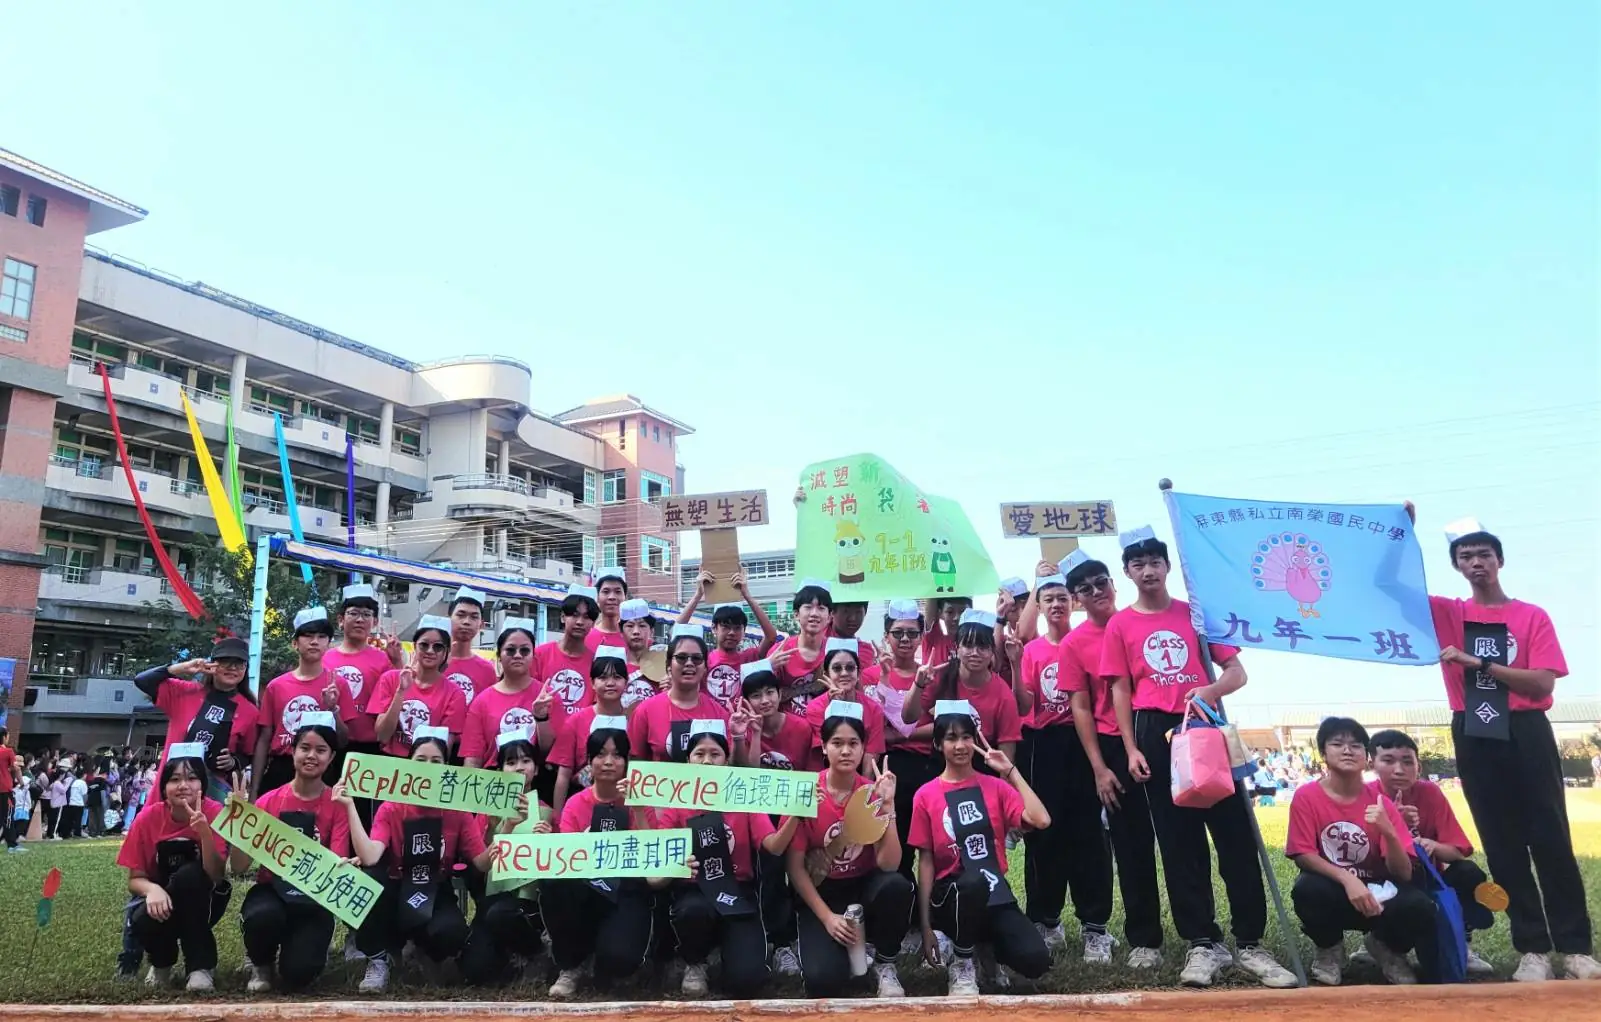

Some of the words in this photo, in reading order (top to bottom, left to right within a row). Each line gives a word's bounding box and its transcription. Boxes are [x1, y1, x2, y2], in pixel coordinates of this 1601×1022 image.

[665, 495, 762, 528] 無塑生活
[1009, 502, 1114, 536] 愛地球
[1195, 507, 1406, 542] 屏東縣私立南榮國民中學
[1148, 634, 1184, 649] Class
[1209, 612, 1420, 660] 九年一班
[1161, 650, 1180, 671] 1
[555, 672, 584, 688] Class
[626, 683, 655, 698] Class
[718, 681, 730, 697] 1
[1150, 674, 1174, 687] The
[1177, 674, 1199, 685] One
[279, 734, 293, 746] Th
[344, 758, 432, 799] Replace
[438, 769, 524, 810] 替代使用
[629, 769, 718, 805] Recycle
[723, 770, 814, 809] 循環再用
[1327, 825, 1367, 845] Class
[219, 800, 295, 867] Reduce
[290, 848, 373, 918] 減少使用
[496, 840, 587, 875] Reuse
[593, 835, 687, 870] 物盡其用
[1337, 842, 1357, 863] 1
